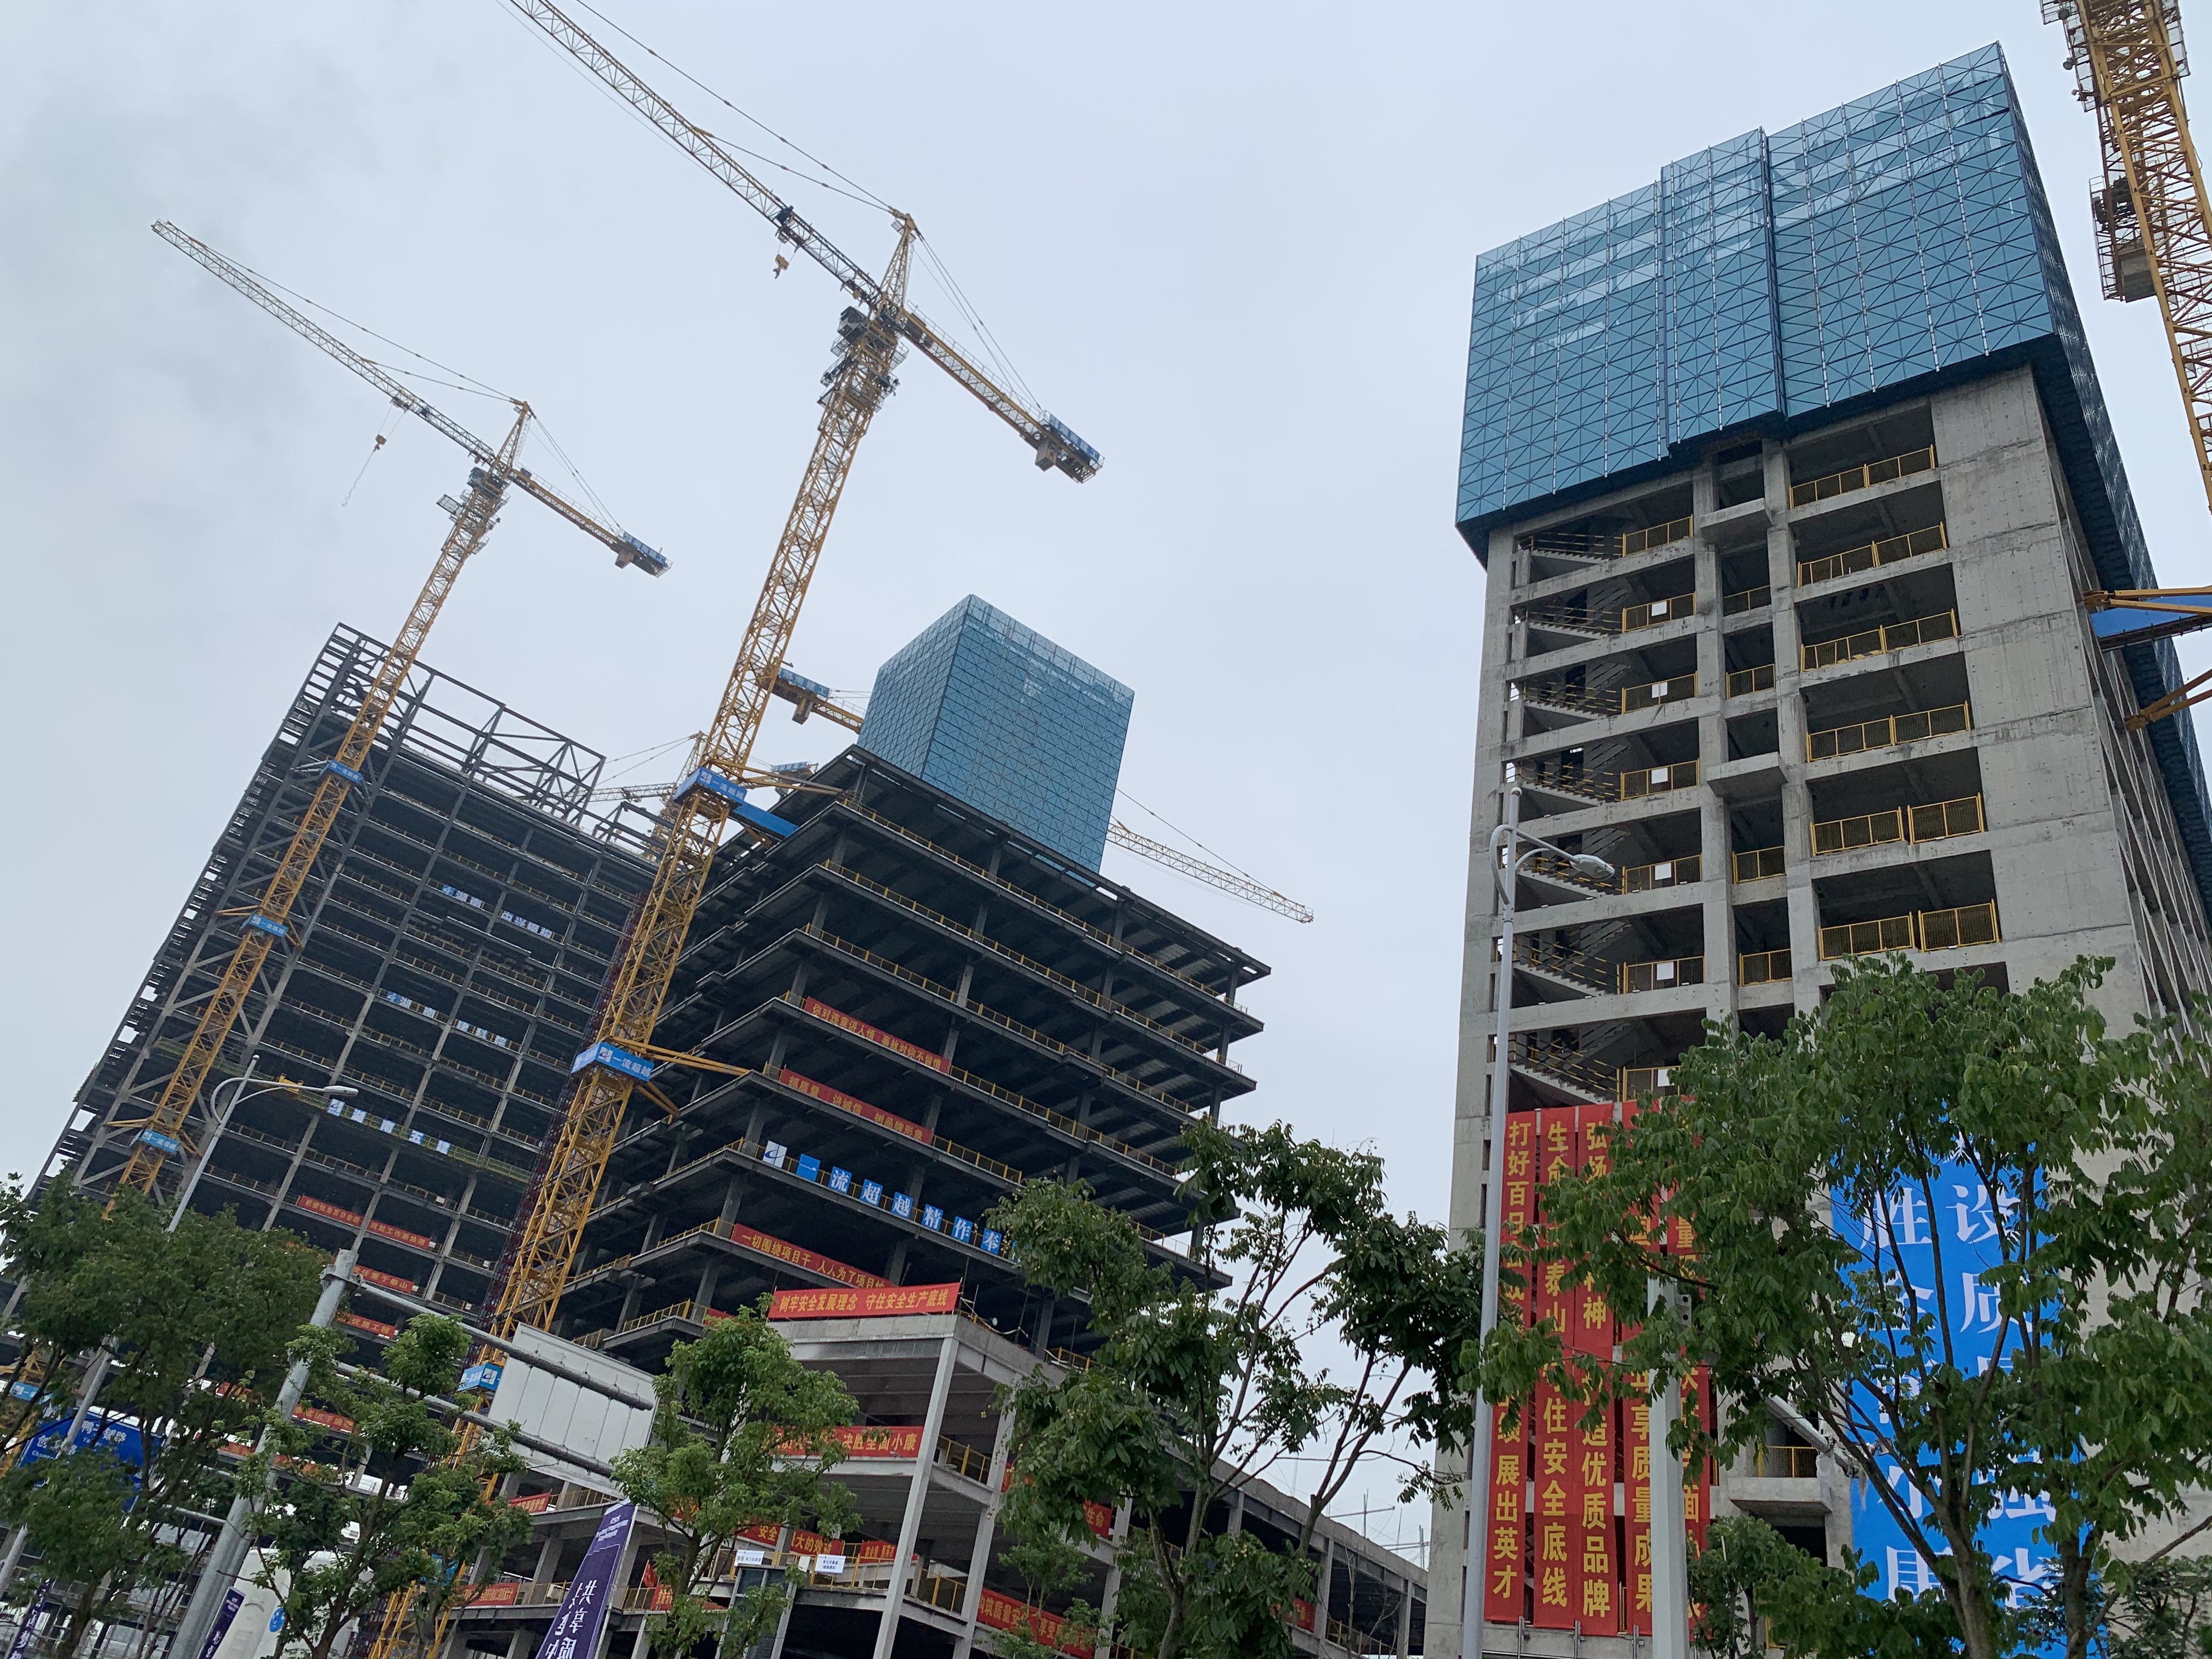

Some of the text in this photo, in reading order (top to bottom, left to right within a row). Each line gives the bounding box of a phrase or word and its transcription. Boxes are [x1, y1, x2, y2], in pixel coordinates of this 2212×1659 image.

[613, 1057, 652, 1077] 一流超越
[812, 1003, 943, 1071] 你对违章讲人情 事故对你不留情
[788, 1076, 923, 1141] 抓质量 讲诚信 树品牌形象
[799, 1161, 1021, 1262] 一流超越精作奉
[1545, 1121, 1569, 1333] 生命泰山
[742, 1233, 811, 1267] 一切围绕项目干
[779, 1289, 949, 1313] 树牢安全发展理念 守住安全生产底线
[1493, 1455, 1520, 1599] 展出英才
